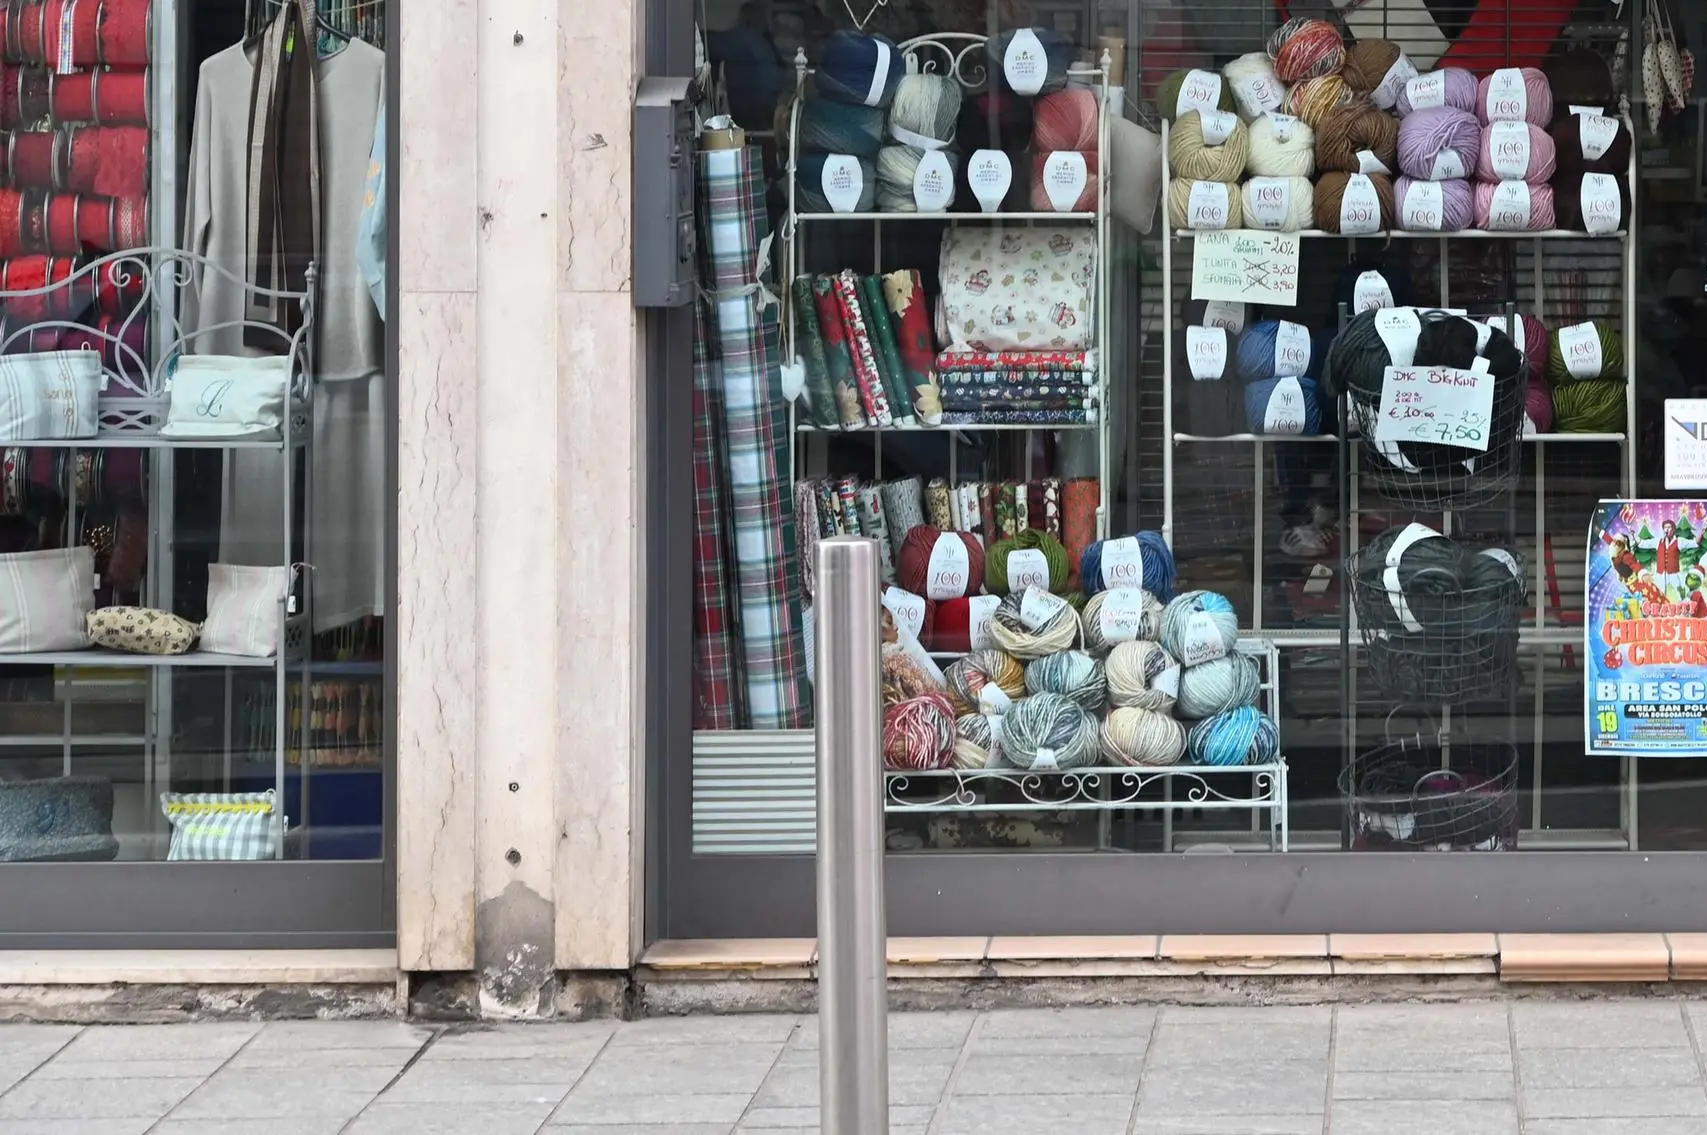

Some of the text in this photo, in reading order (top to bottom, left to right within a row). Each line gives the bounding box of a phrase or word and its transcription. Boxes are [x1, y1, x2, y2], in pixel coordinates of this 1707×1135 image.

[1494, 101, 1520, 113] 100
[1498, 142, 1524, 155] 100
[1257, 188, 1283, 203] 100
[1589, 199, 1615, 213] 100
[1196, 206, 1222, 221] 100
[1199, 232, 1230, 245] LANA
[1272, 263, 1297, 276] 3,20
[1282, 346, 1306, 361] 100
[1569, 341, 1595, 355] 100
[1392, 370, 1416, 381] DMC
[1272, 418, 1299, 431] 100
[1434, 423, 1482, 442] 7,50
[1109, 563, 1137, 577] 100
[934, 571, 962, 585] 100
[1015, 571, 1043, 585] 100
[1597, 704, 1616, 712] DAL
[1628, 704, 1656, 712] AREA
[1658, 704, 1682, 712] SAN
[1596, 711, 1618, 733] 19
